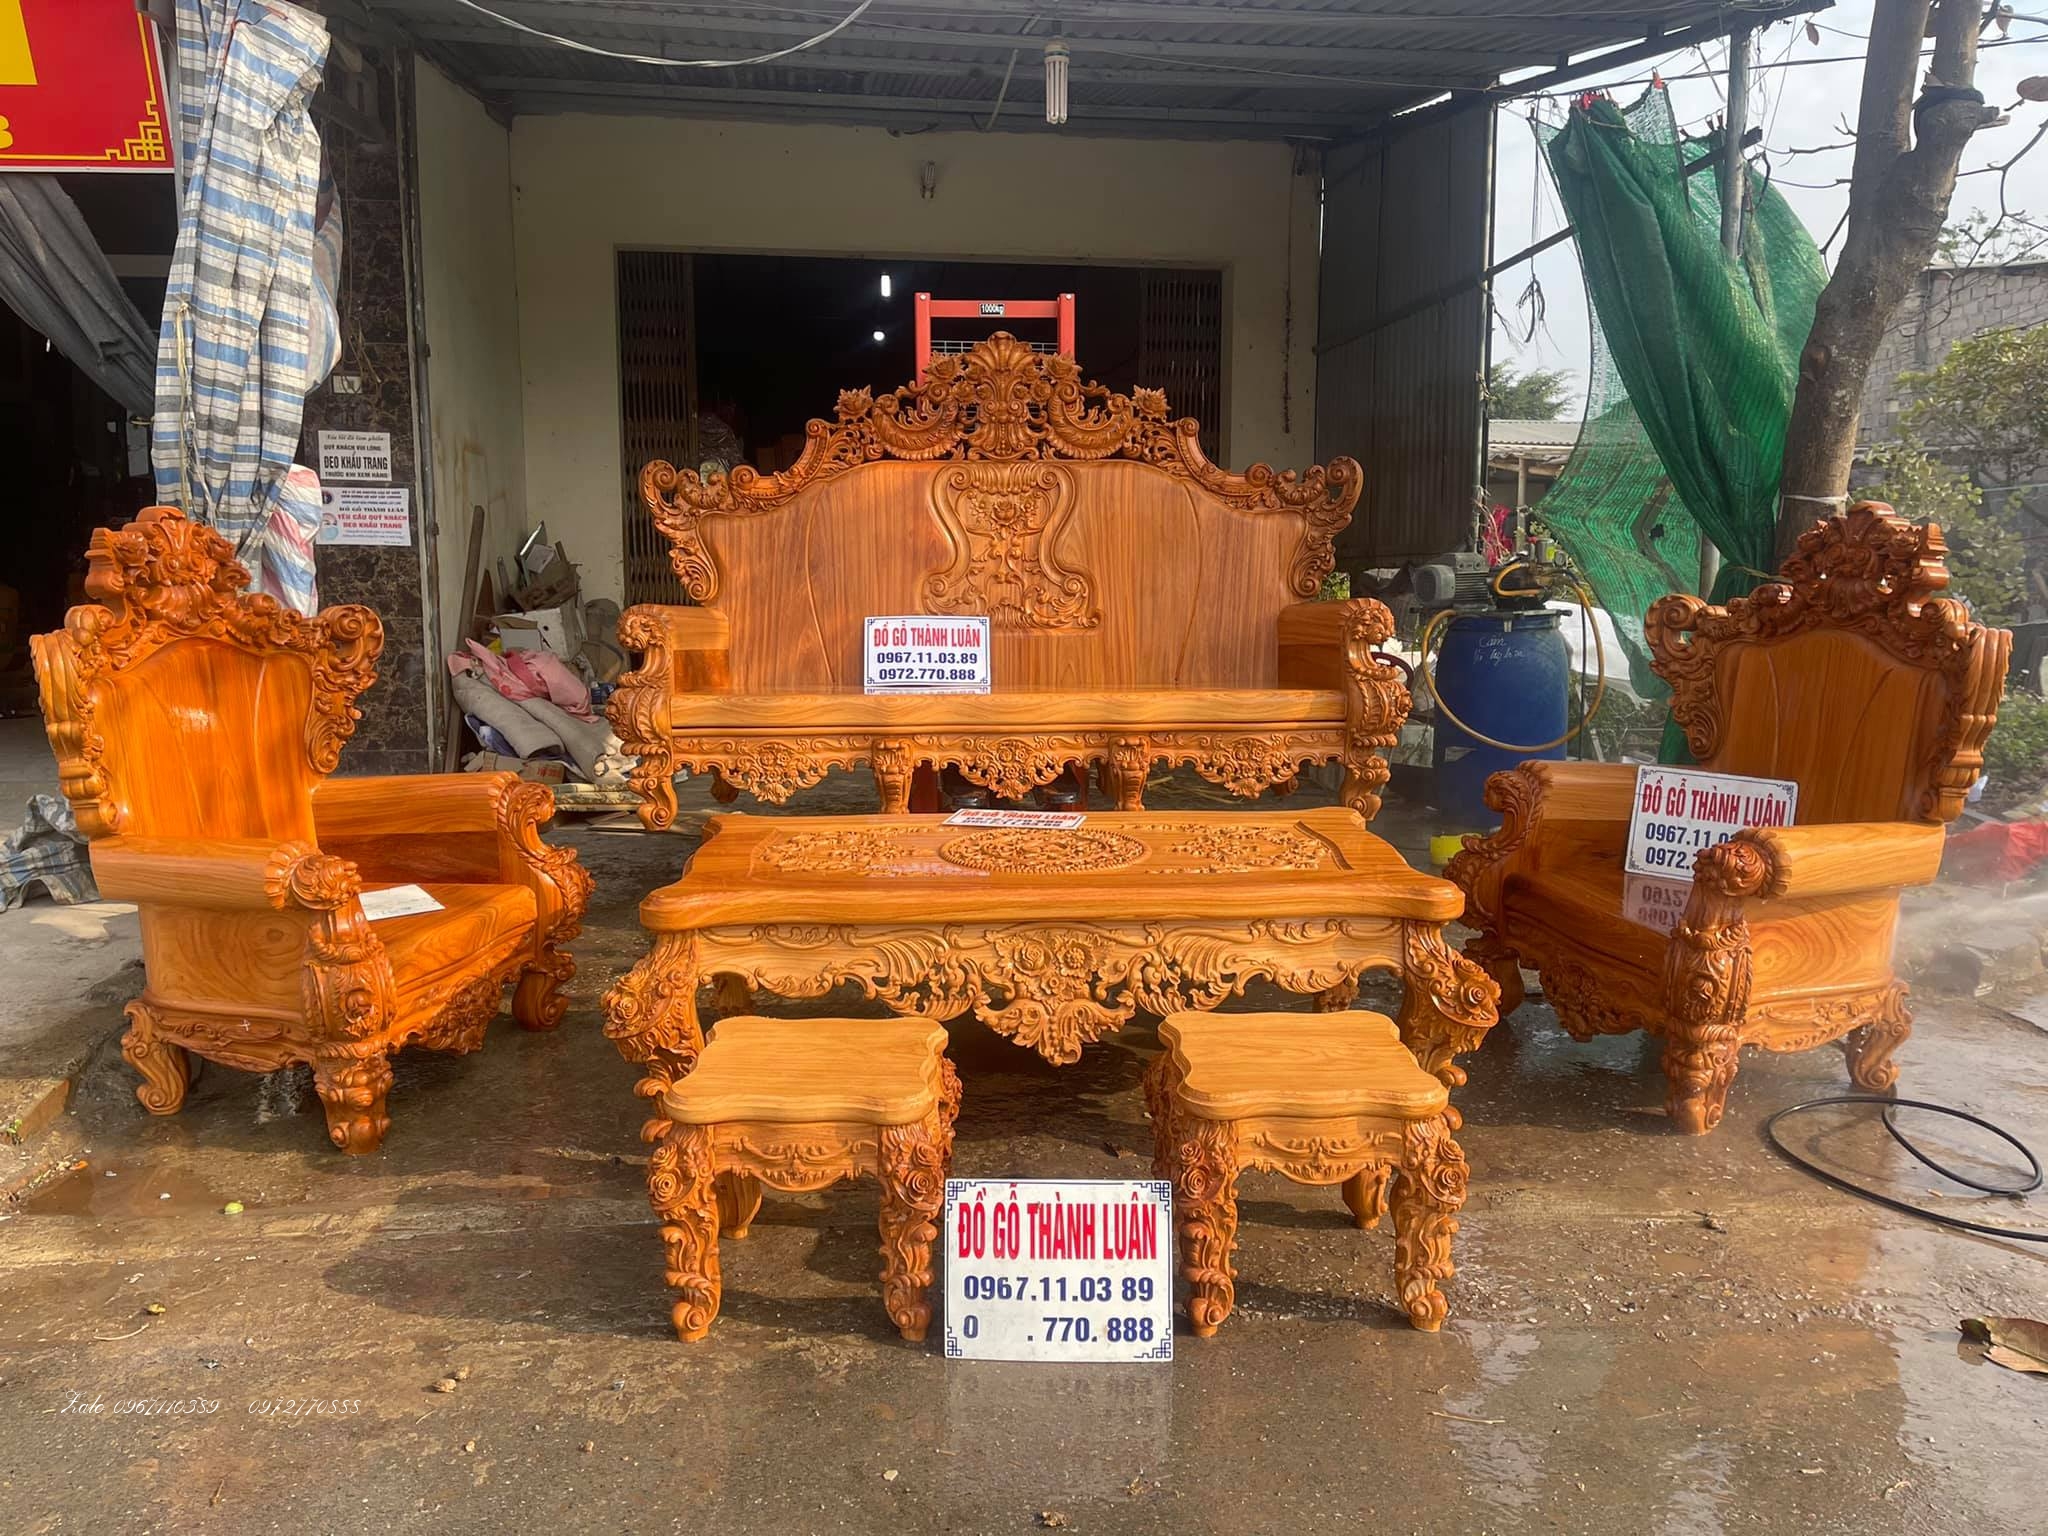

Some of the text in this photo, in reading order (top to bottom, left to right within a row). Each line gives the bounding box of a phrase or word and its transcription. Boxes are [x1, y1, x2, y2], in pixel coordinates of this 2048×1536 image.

[323, 451, 388, 470] ĐEO KHẨU TRANG
[874, 620, 981, 648] ĐỒ GỖ THÀNH LUÂN
[877, 652, 978, 664] 0967.11.03.89
[879, 668, 976, 681] 0972.770.888
[1641, 776, 1787, 828] ĐỒ GỖ THÀNH LUÂN
[958, 1183, 1157, 1260] ĐỒ GỖ THÀNH LUÂN
